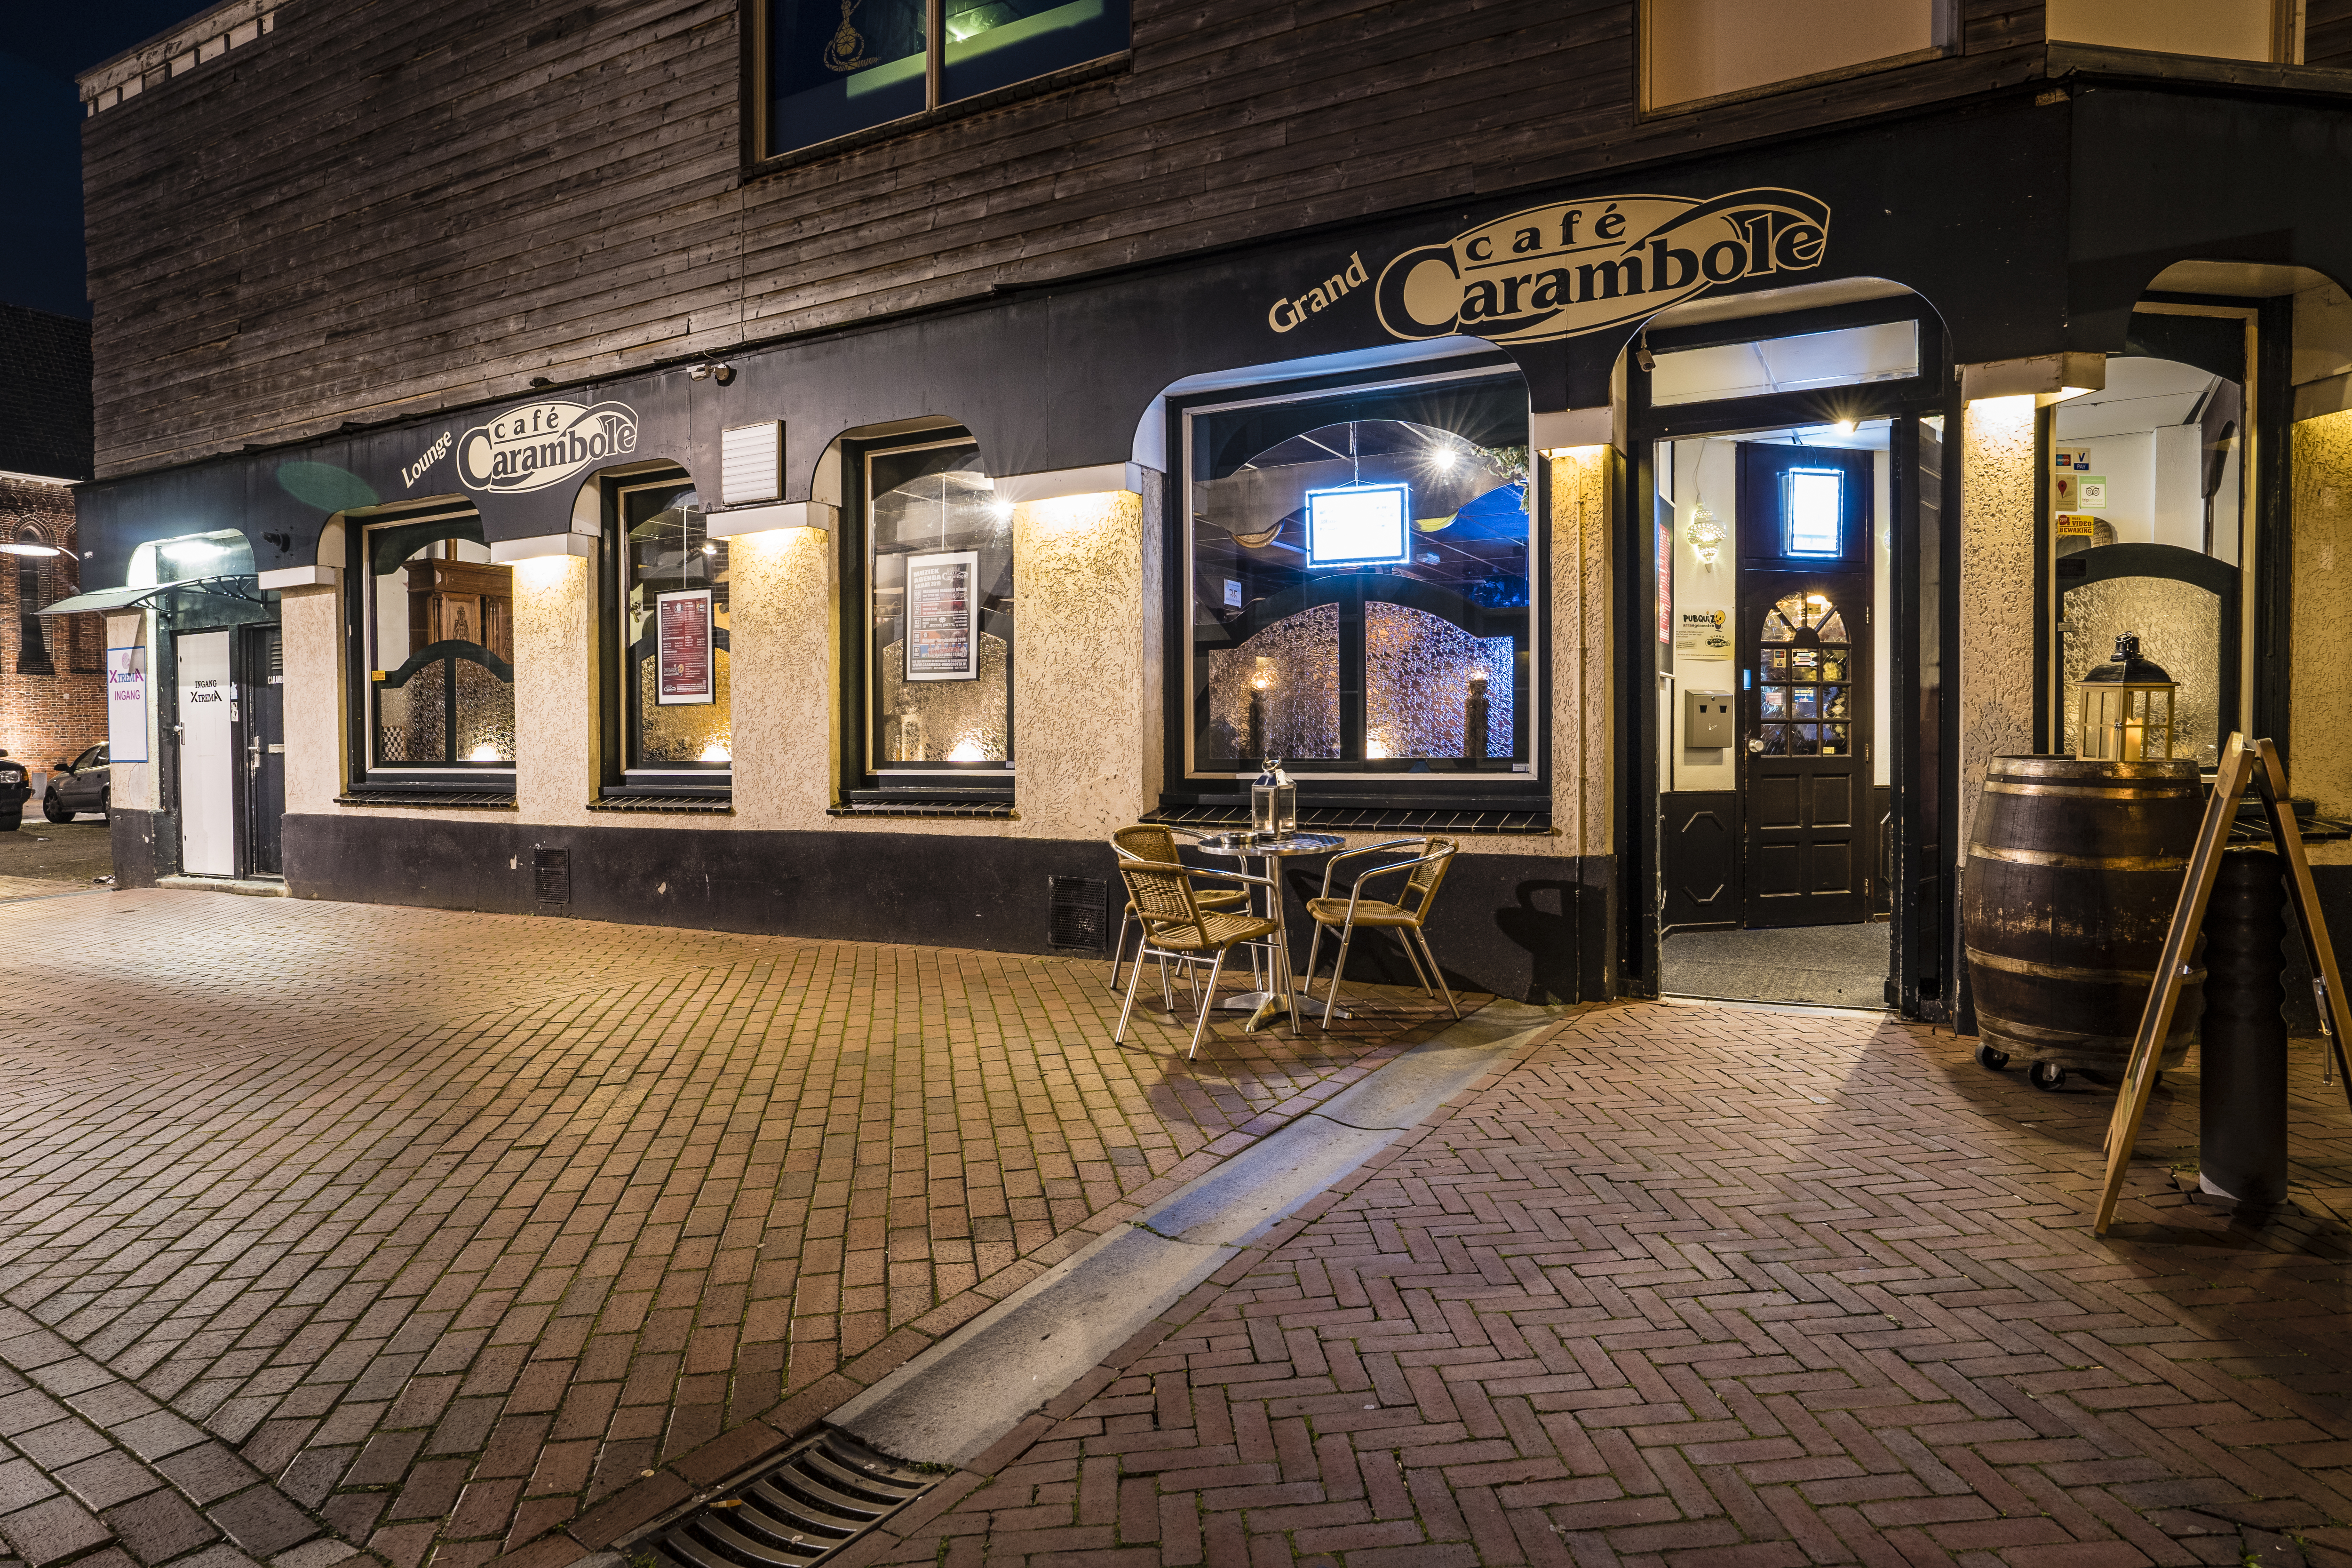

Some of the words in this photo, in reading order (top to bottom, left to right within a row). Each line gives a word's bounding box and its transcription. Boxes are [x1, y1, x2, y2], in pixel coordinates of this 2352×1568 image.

[1464, 202, 1627, 262] café
[1376, 212, 1826, 340] Carambole
[1269, 252, 1370, 333] Grand
[494, 406, 559, 439] café
[457, 416, 638, 490] Carambole
[2076, 452, 2086, 462] V
[402, 430, 452, 489] Lounge
[913, 568, 939, 578] MUZIEK
[914, 574, 942, 583] AGENDA
[675, 602, 683, 611] SOB
[1683, 614, 1716, 623] PUBQUIZ
[195, 680, 217, 688] INGANG
[114, 690, 140, 701] INGANG
